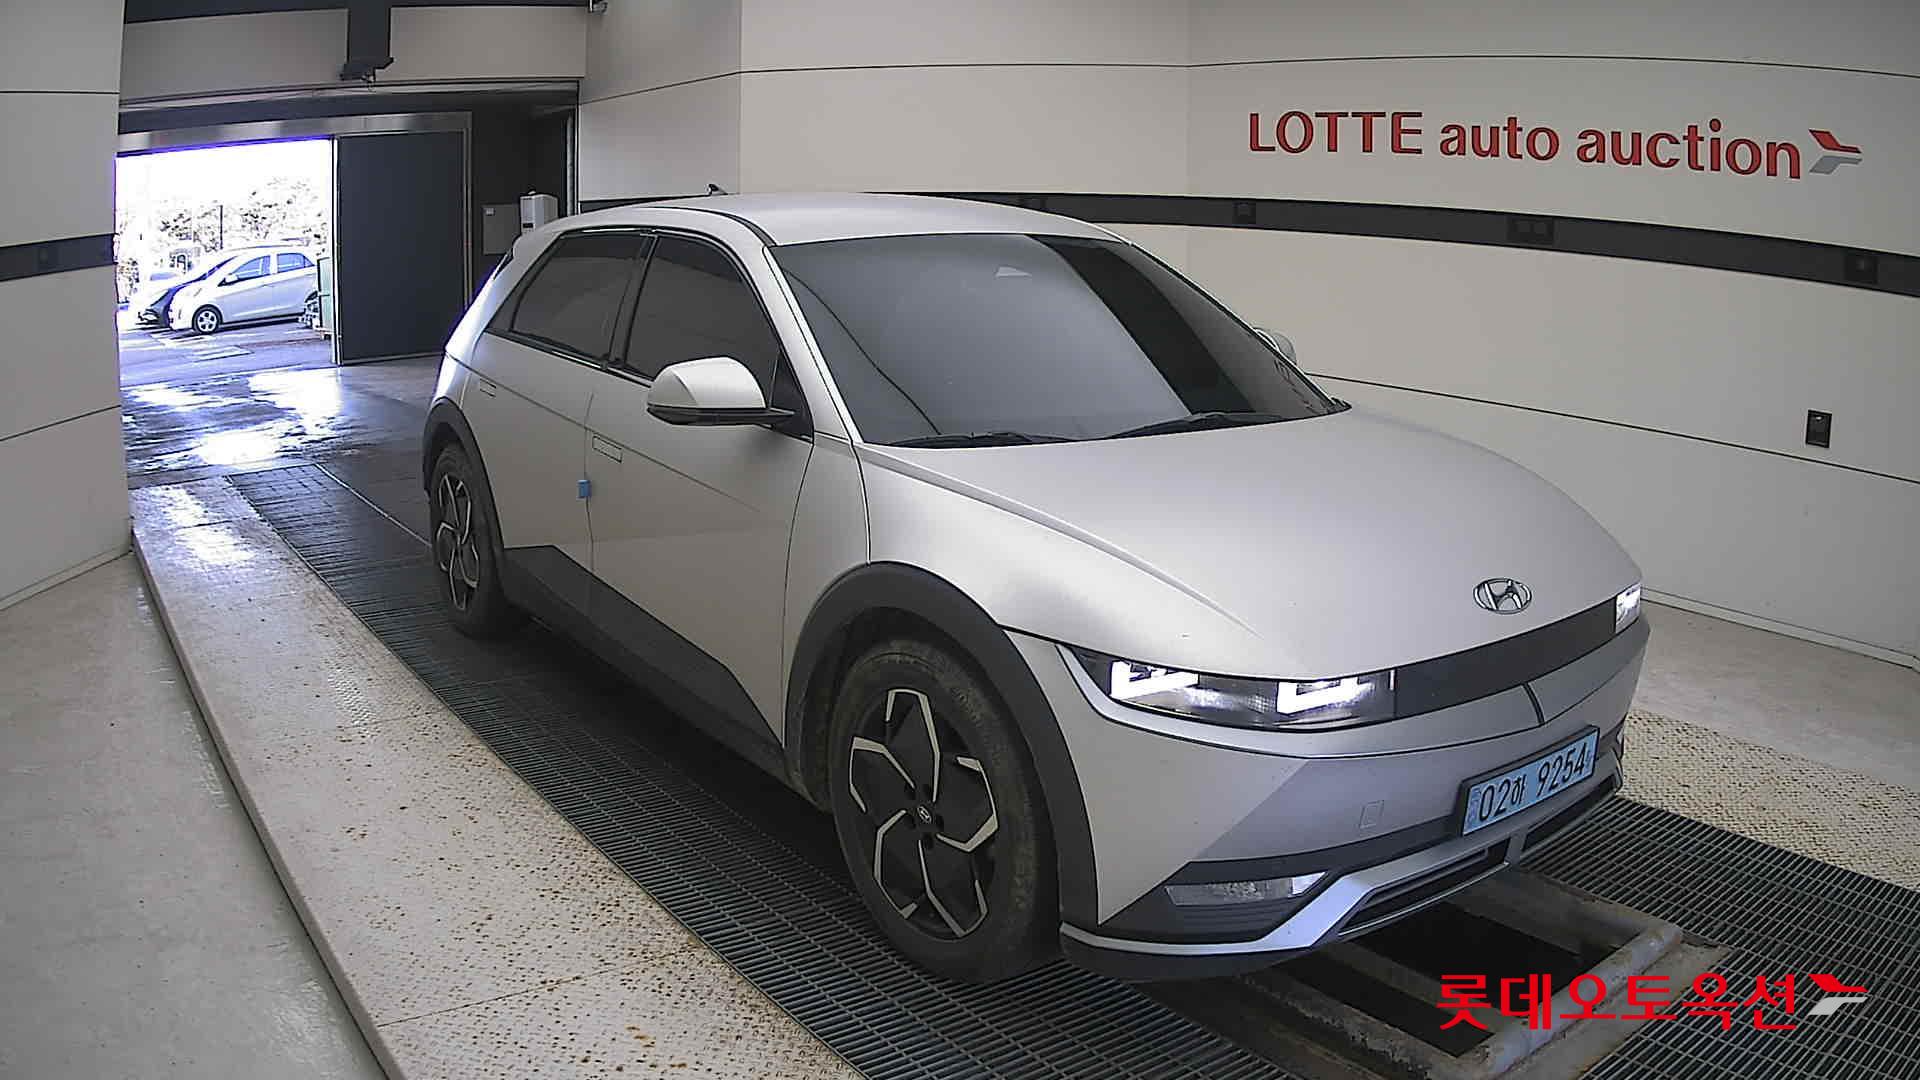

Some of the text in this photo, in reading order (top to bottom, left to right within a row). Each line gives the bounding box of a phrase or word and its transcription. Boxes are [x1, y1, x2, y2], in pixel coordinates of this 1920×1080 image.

[1249, 111, 1801, 180] LOTTE auto auction
[1479, 742, 1588, 822] 02하 9254
